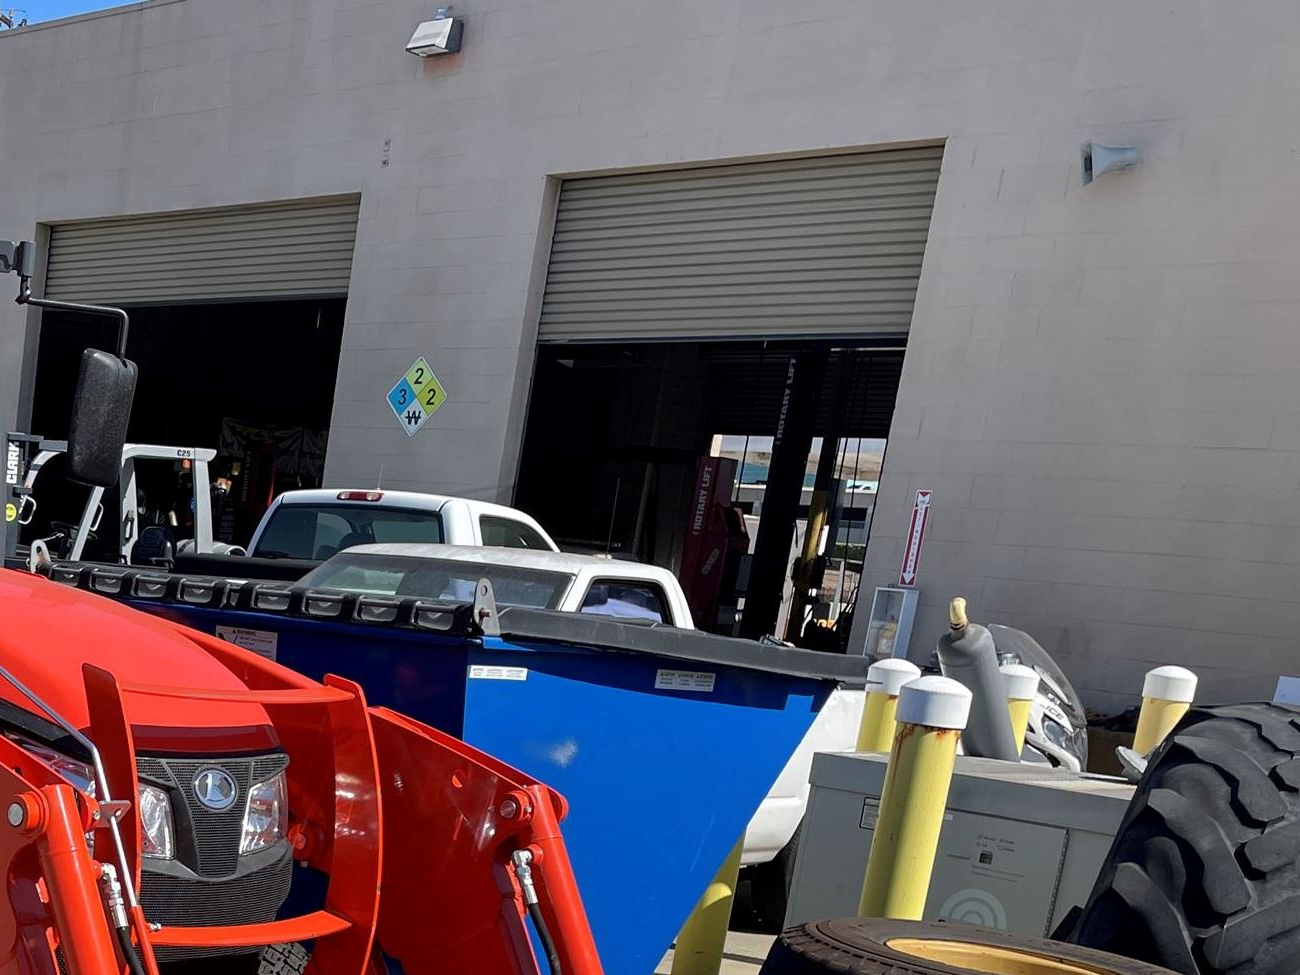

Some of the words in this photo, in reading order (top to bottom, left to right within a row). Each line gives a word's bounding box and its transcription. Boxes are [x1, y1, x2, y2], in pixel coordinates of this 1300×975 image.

[414, 368, 424, 384] 2
[398, 389, 407, 405] 3
[426, 389, 436, 405] 2
[6, 442, 19, 484] CLARK
[695, 489, 708, 530] ROTARY
[703, 466, 712, 488] LIFT
